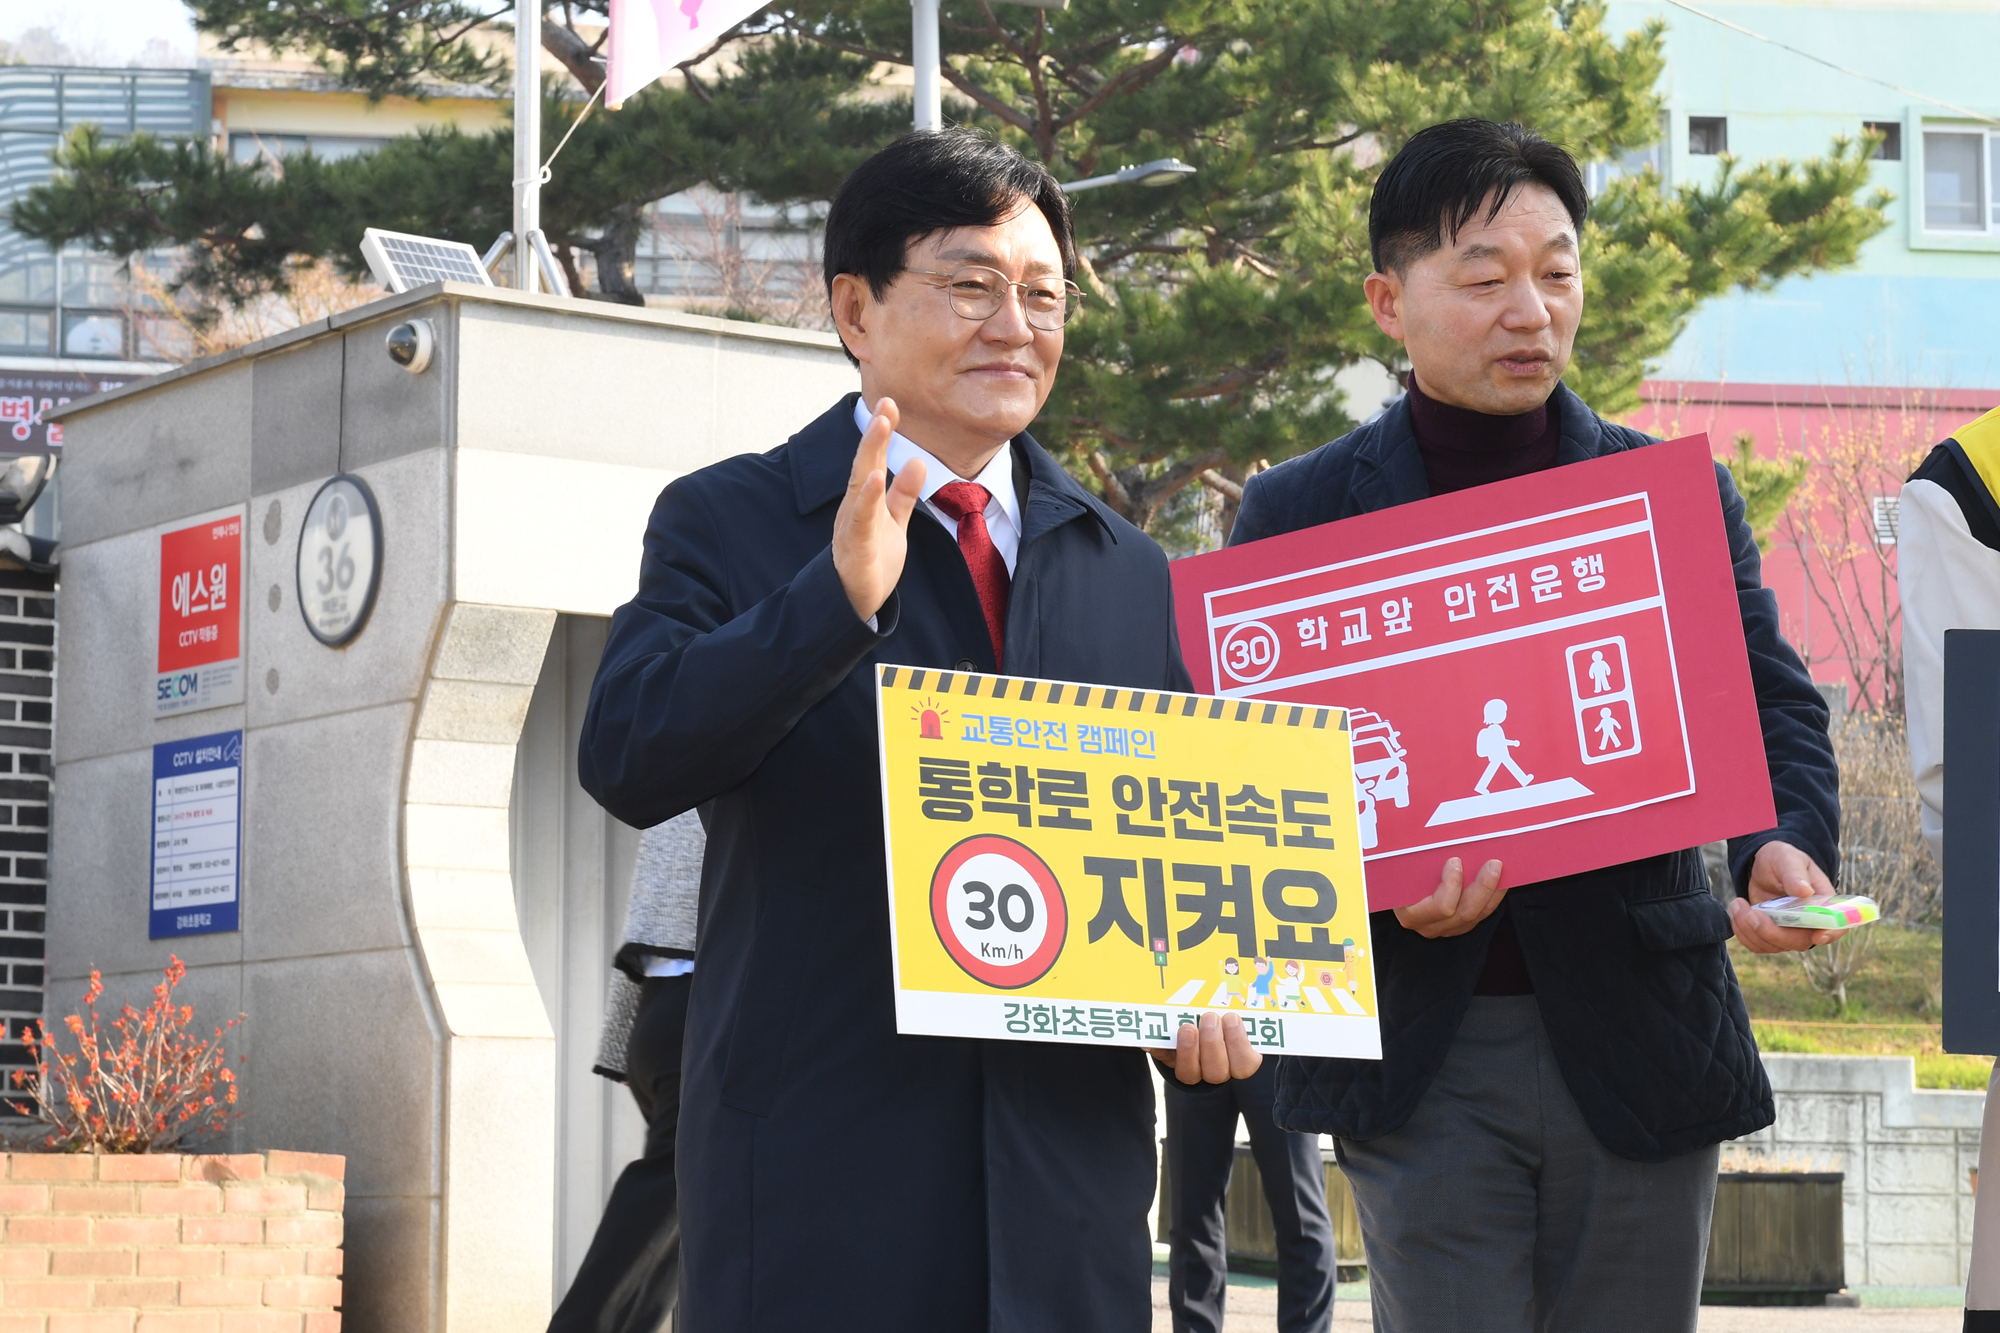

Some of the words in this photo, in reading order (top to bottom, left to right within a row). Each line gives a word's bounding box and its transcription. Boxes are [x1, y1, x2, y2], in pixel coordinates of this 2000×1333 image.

[172, 563, 227, 618] 에스원
[316, 542, 355, 595] 36
[1297, 597, 1413, 651] 학교앞
[1444, 553, 1606, 623] 안전운행
[179, 629, 198, 648] CCTV
[1229, 635, 1271, 673] 30
[157, 672, 198, 700] SECOM
[173, 751, 194, 767] CCTV
[961, 714, 1068, 752] 교통안전
[1077, 723, 1157, 760] 캠페인
[918, 757, 1092, 831] 통학로
[1112, 774, 1335, 850] 안전속도
[962, 881, 1034, 933] 30
[1083, 855, 1345, 963] 지켜요
[980, 941, 1024, 961] Km/h
[1004, 1003, 1171, 1041] 강화초등학교
